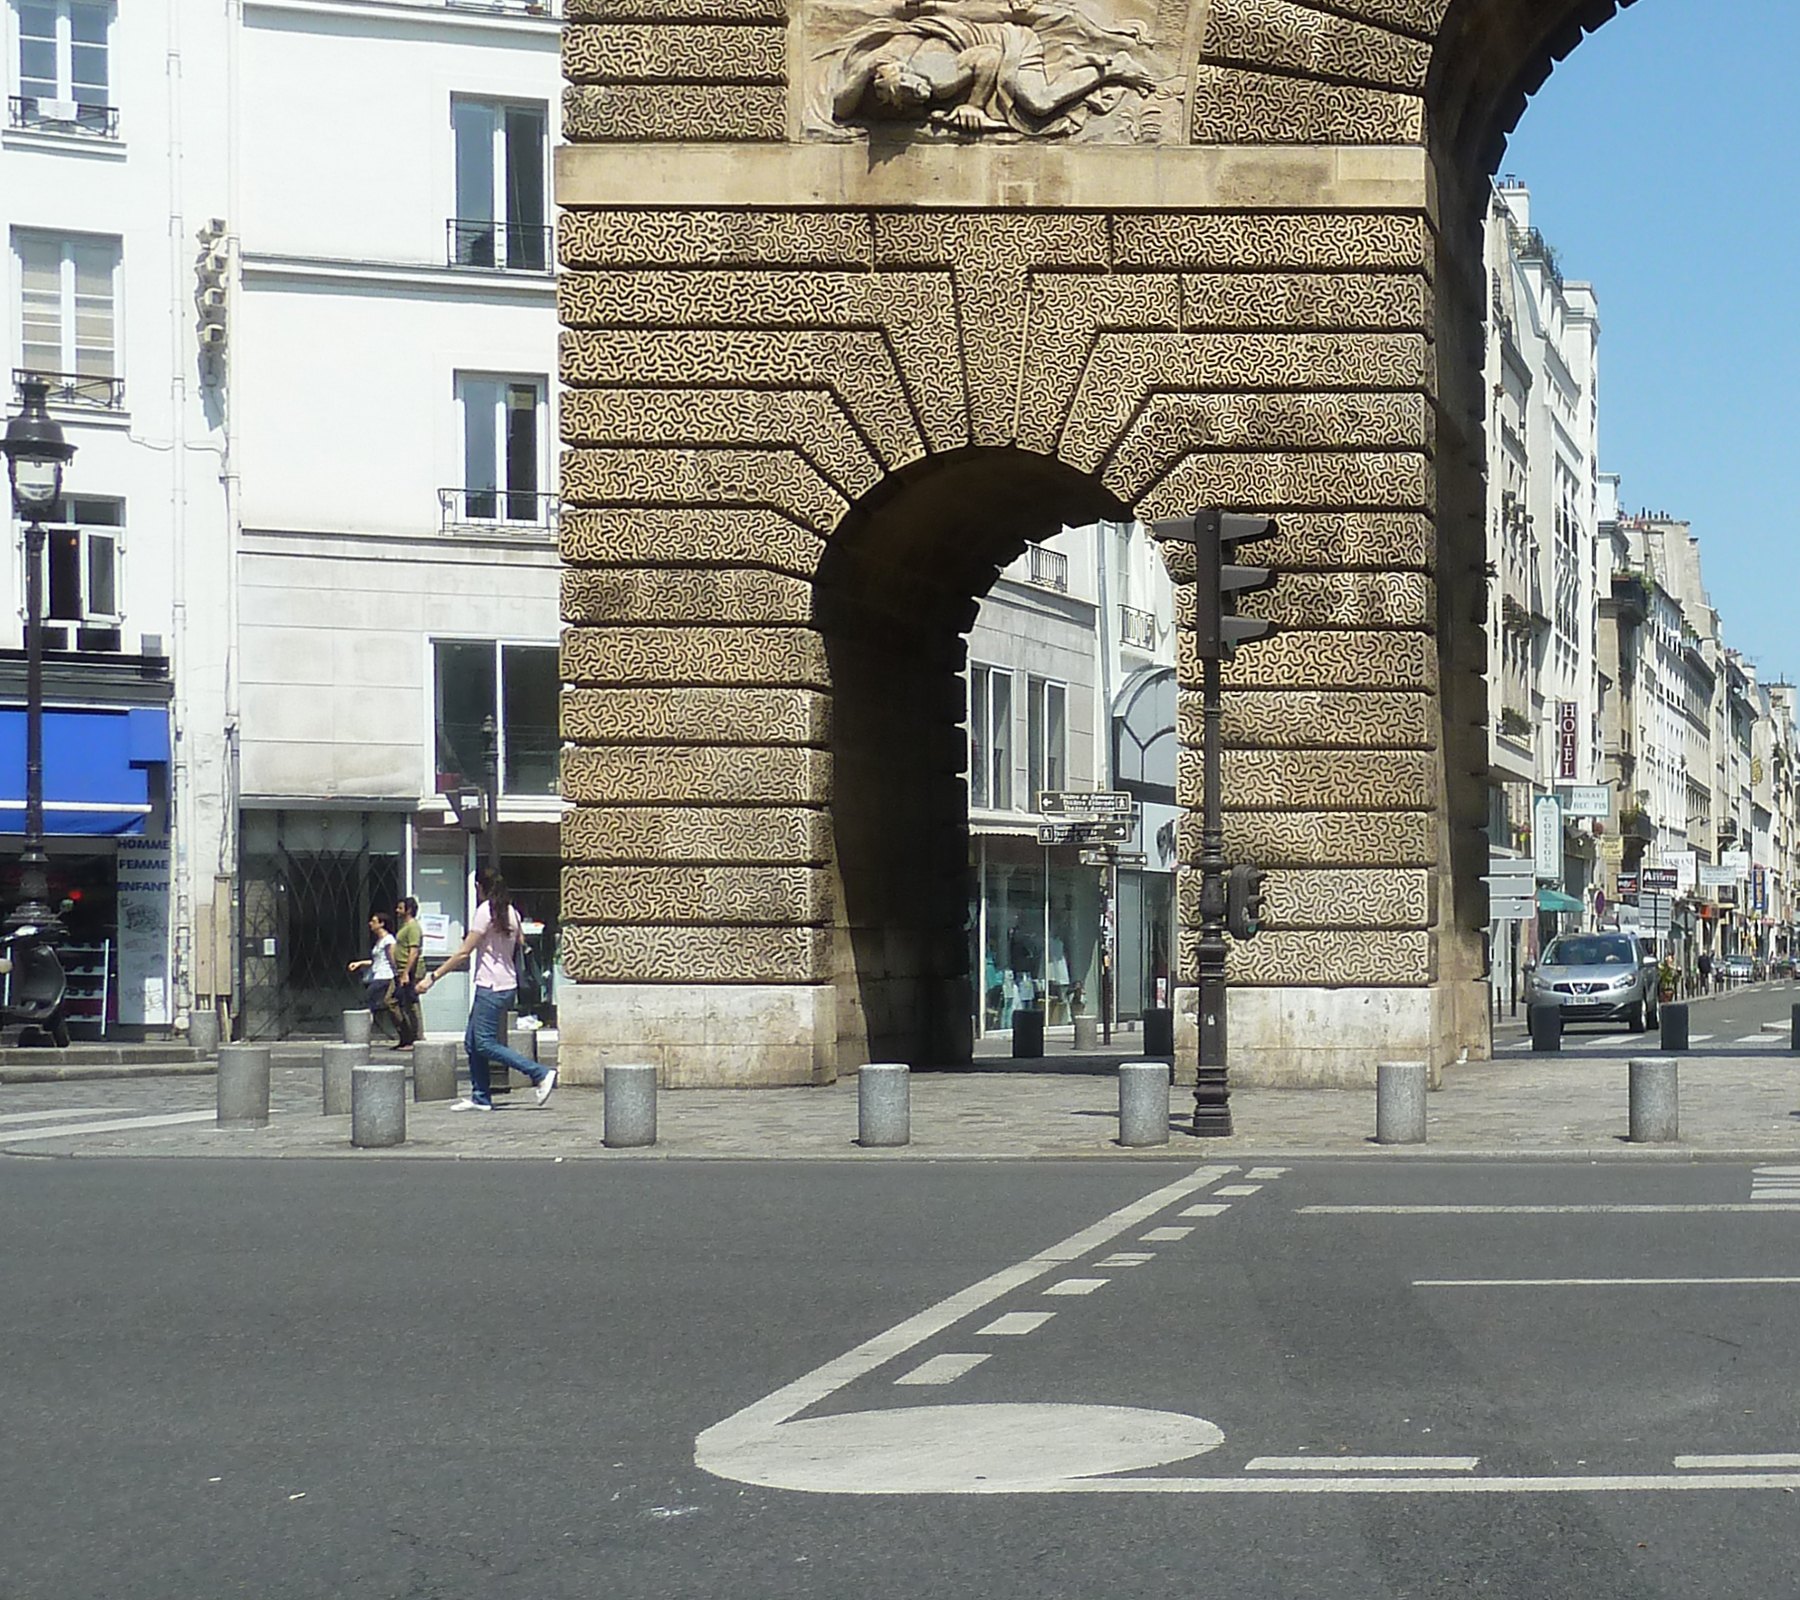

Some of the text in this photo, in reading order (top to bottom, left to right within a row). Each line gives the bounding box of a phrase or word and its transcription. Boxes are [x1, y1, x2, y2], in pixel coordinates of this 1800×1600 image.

[1562, 703, 1575, 777] HOTEL
[118, 838, 170, 850] HOMME
[119, 859, 169, 870] FEMME
